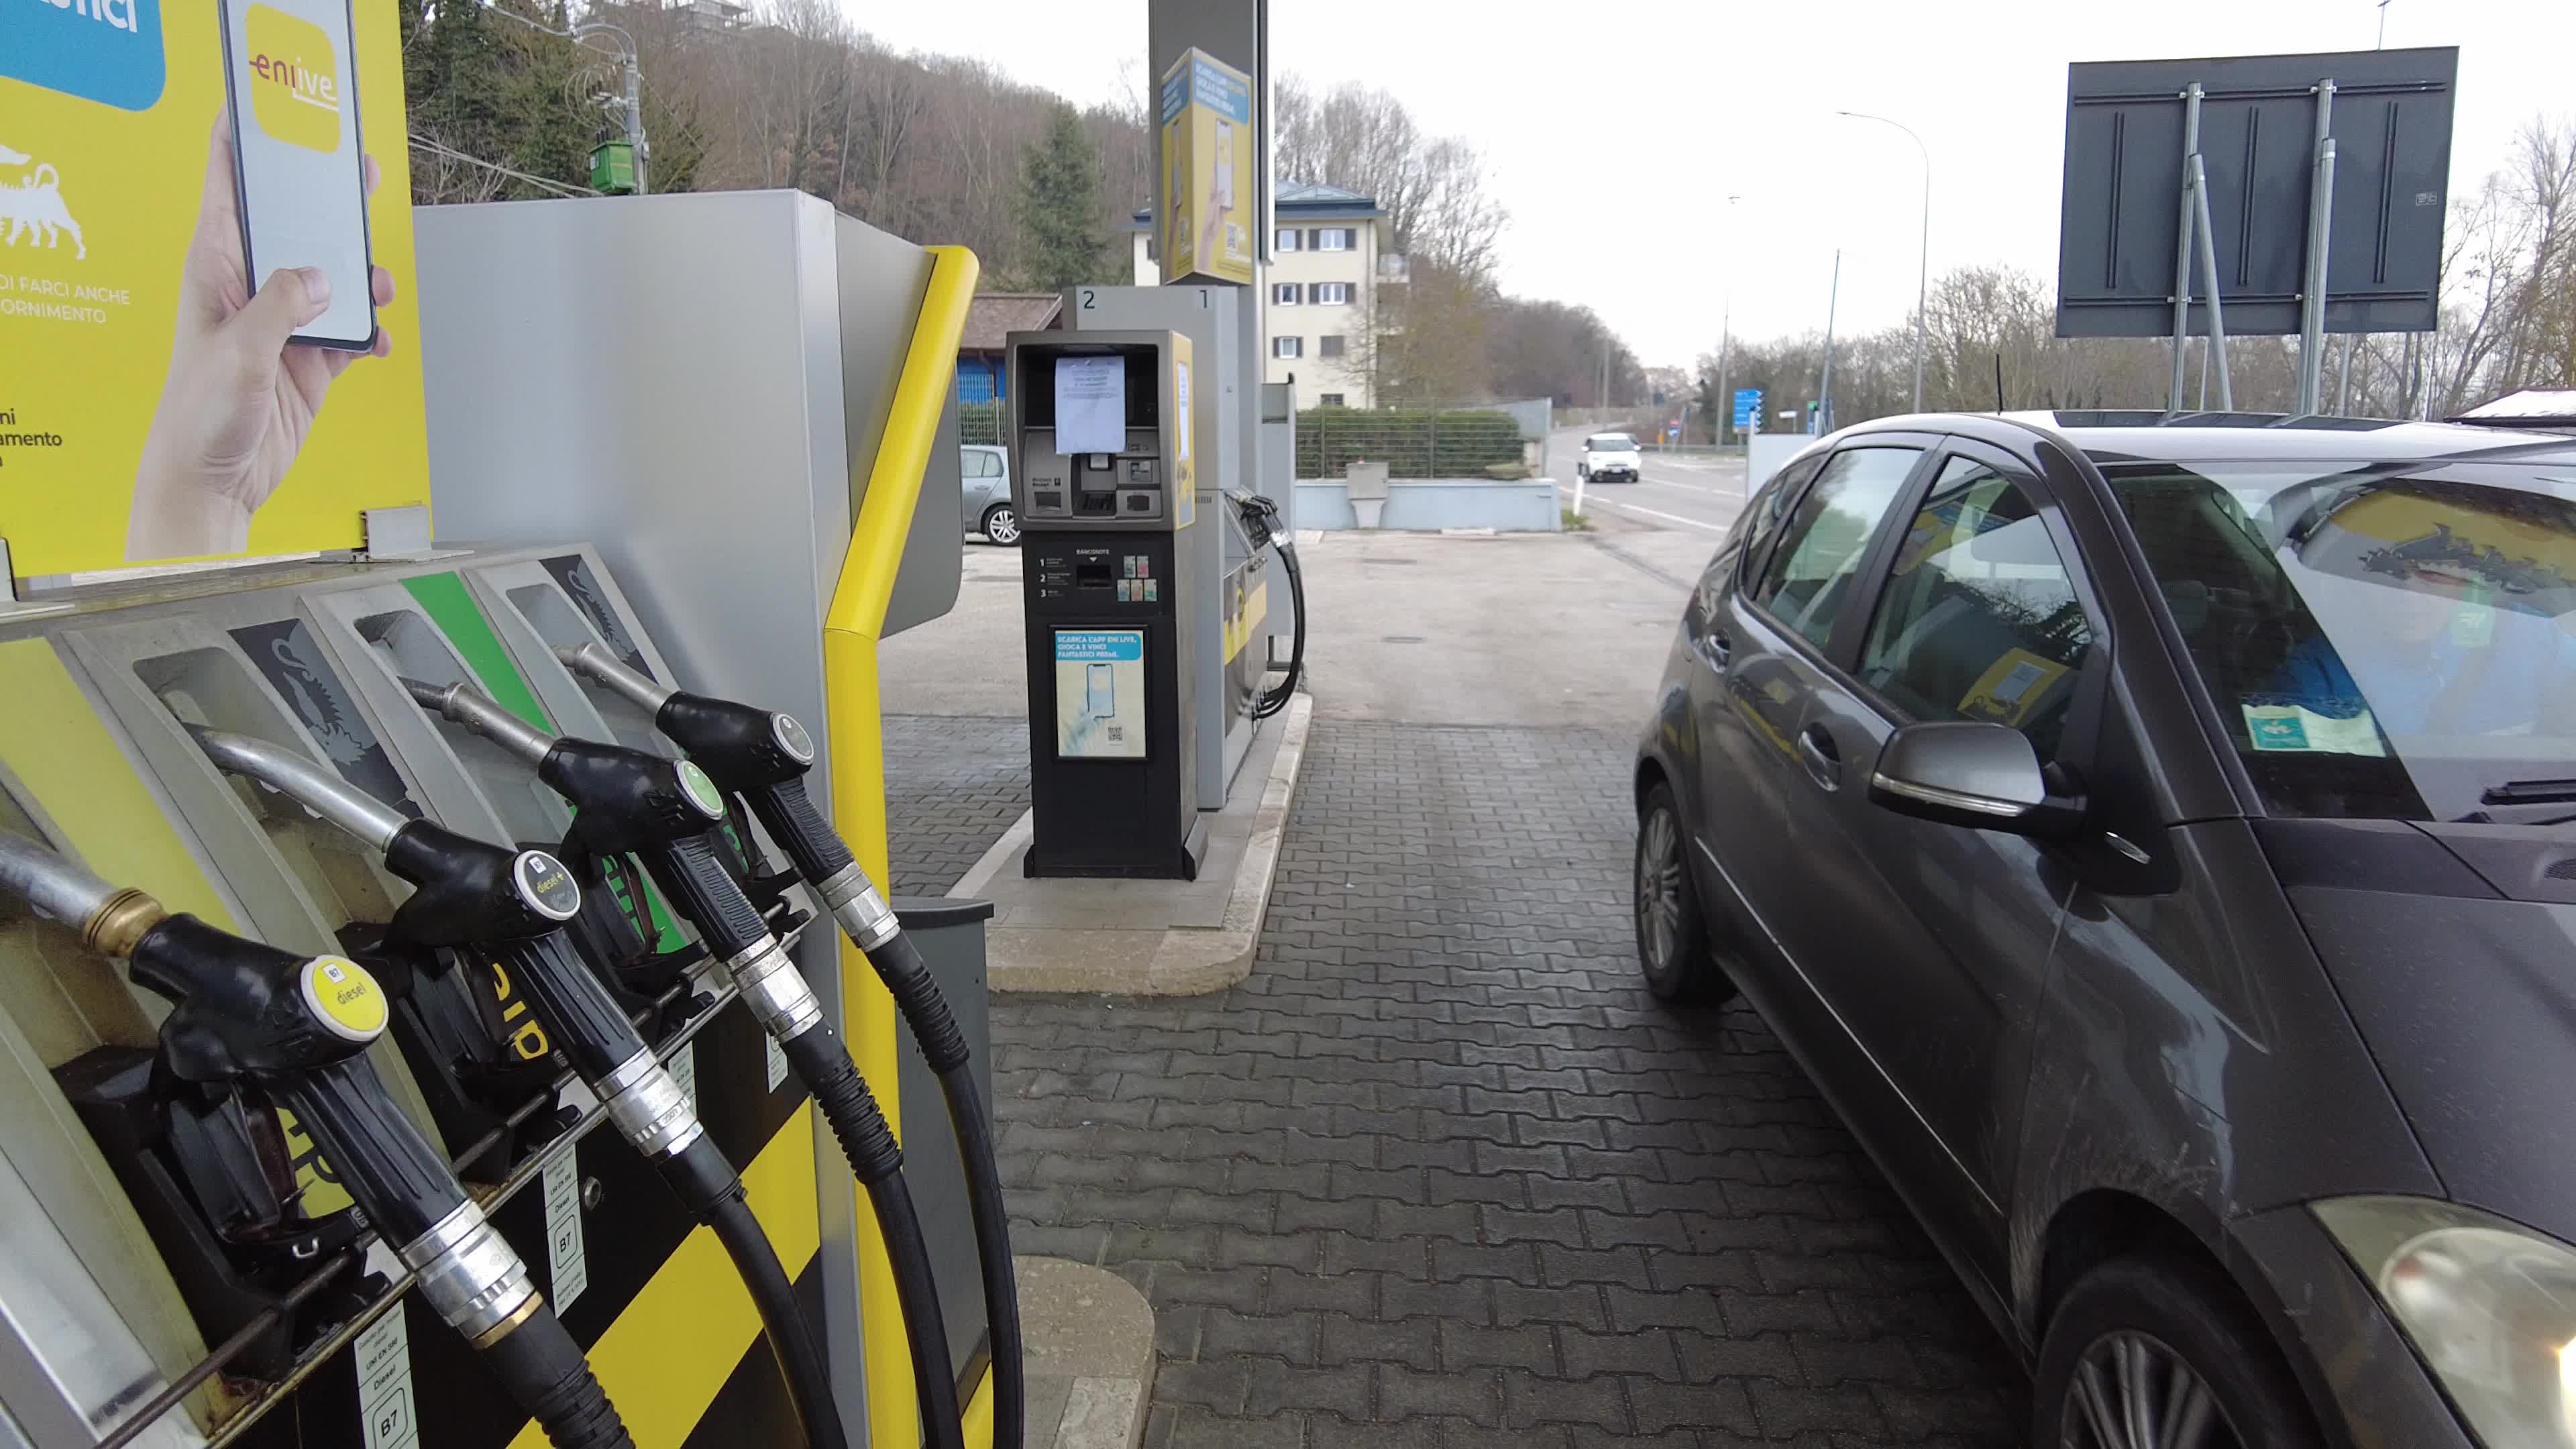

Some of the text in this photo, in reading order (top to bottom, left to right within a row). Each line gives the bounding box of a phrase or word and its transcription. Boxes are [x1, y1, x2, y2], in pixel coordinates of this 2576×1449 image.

[20, 276, 70, 299] FARCI
[74, 284, 129, 305] ANCHE
[1083, 290, 1095, 309] 2
[1199, 289, 1208, 309] 1
[1, 298, 107, 324] ORNIMENTO
[1040, 558, 1044, 567] 1
[1040, 574, 1046, 582] 2
[1040, 589, 1046, 598] 3
[337, 981, 367, 1004] diesel
[555, 1194, 570, 1214] Diesel
[559, 1231, 572, 1253] B7
[366, 1356, 378, 1371] UNI
[378, 1347, 387, 1360] EN
[374, 1363, 396, 1391] Diesel
[381, 1408, 398, 1438] B7
